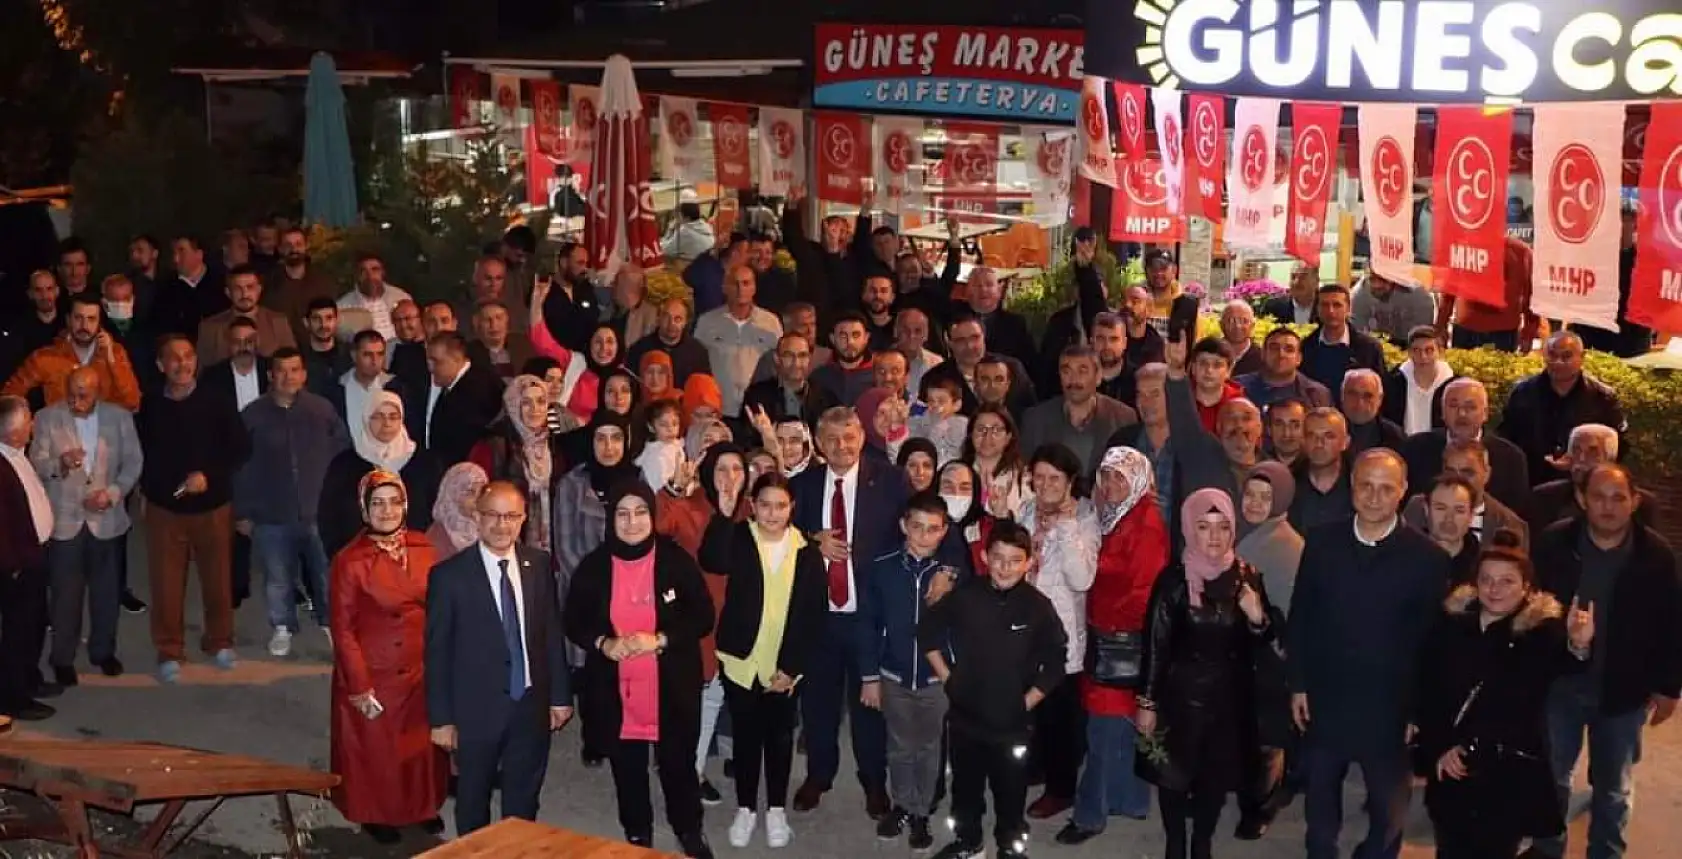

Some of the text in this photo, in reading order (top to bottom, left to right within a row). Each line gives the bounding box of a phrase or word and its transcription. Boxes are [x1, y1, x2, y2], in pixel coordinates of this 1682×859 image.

[824, 29, 939, 75] GÜNEŞ
[876, 81, 1058, 114] CAFETERYA
[1126, 216, 1171, 234] MHP
[1449, 244, 1489, 274] MHP
[1549, 265, 1597, 297] MHP
